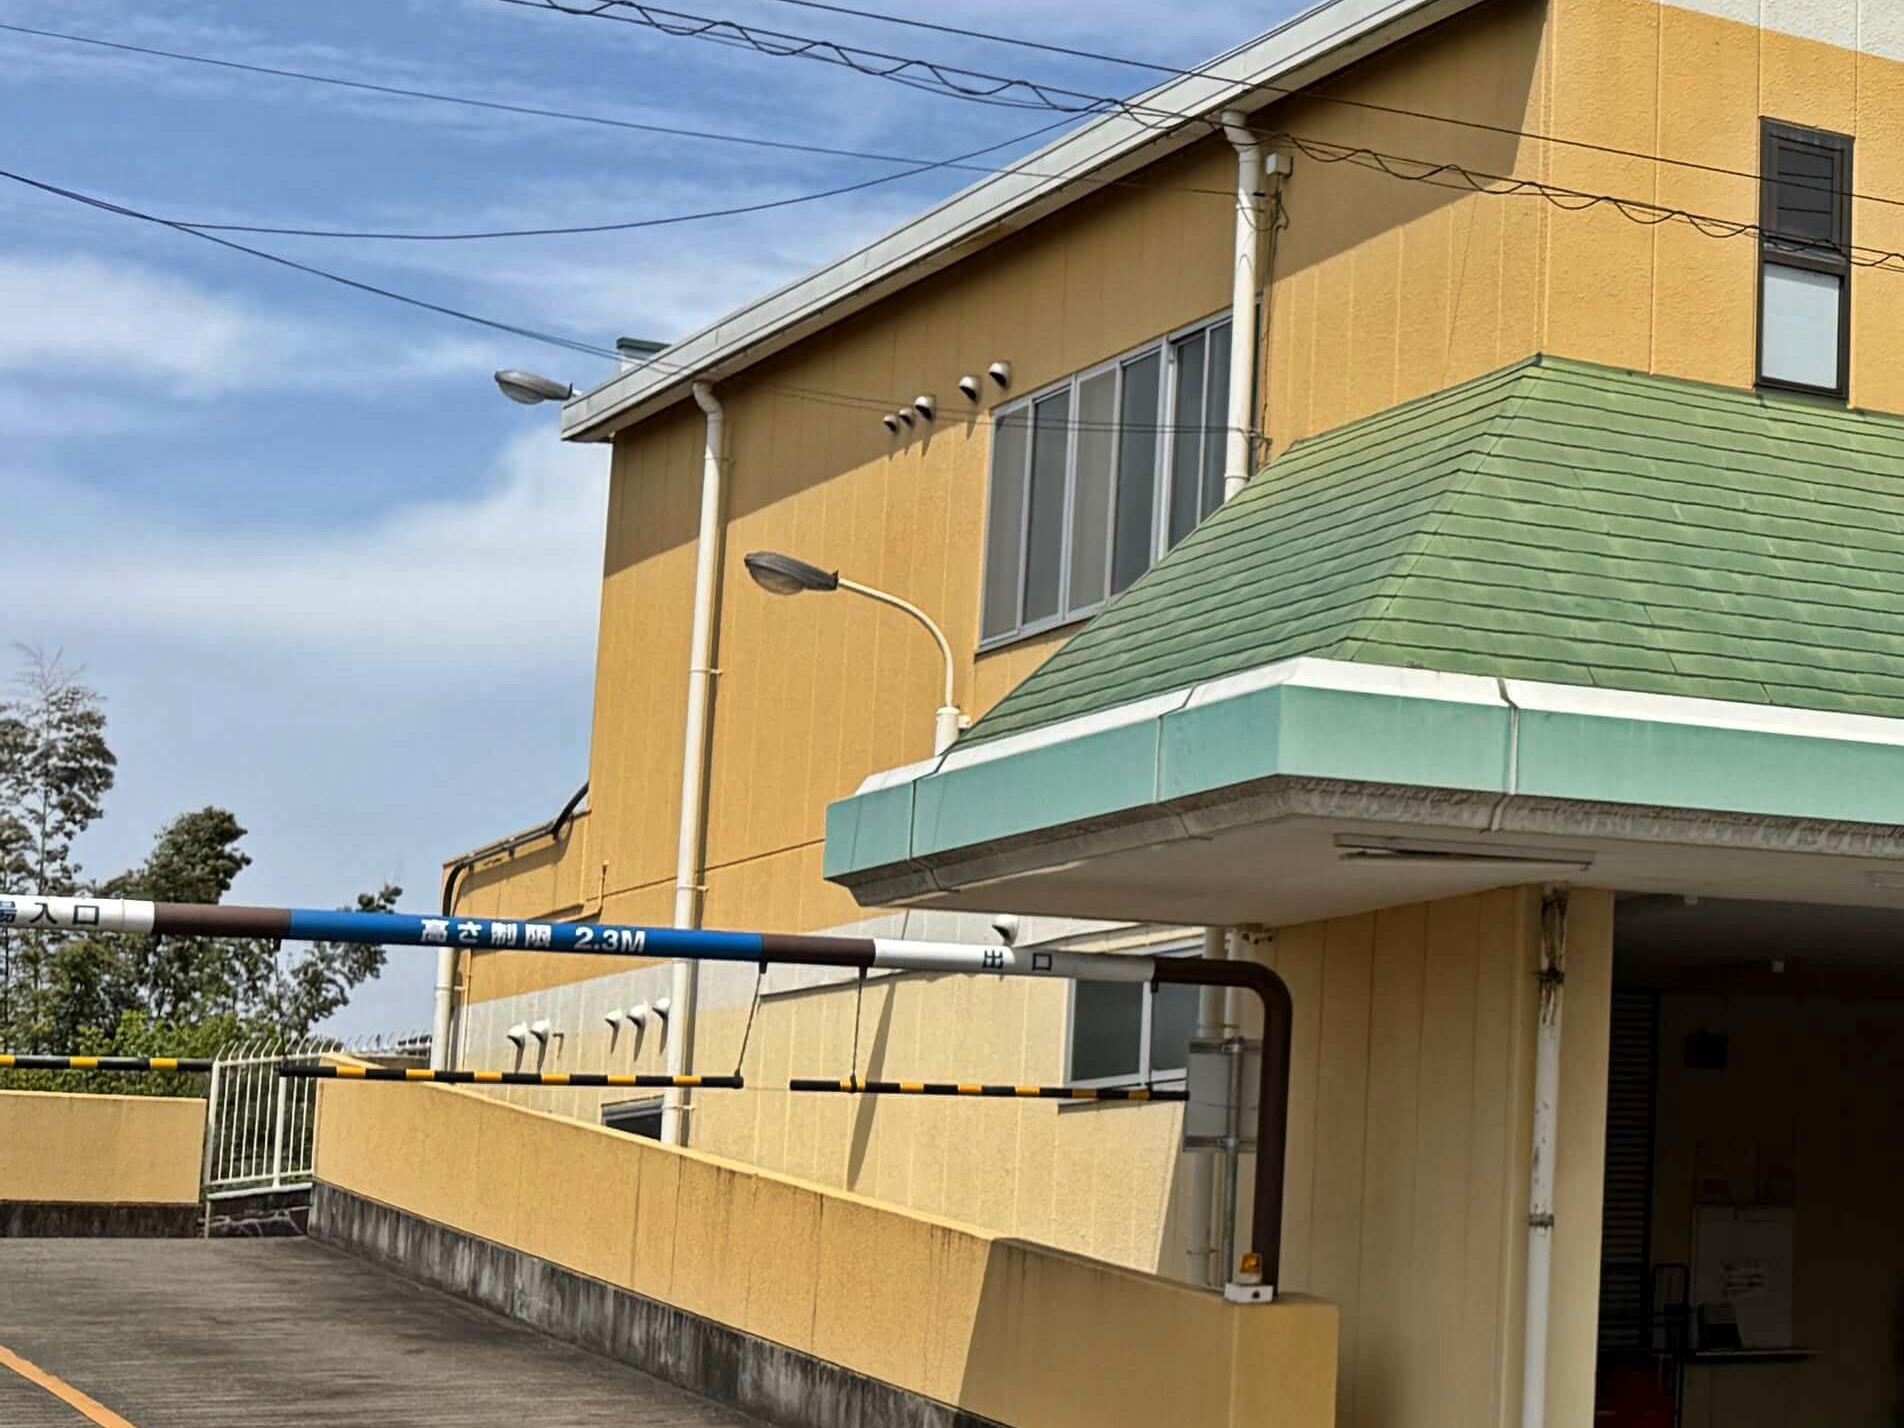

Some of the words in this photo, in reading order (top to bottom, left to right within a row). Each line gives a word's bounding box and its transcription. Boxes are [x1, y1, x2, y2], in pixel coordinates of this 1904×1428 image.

[420, 919, 552, 948] 高さ制限
[574, 925, 646, 953] 2.3M
[982, 948, 1052, 971] 出口
